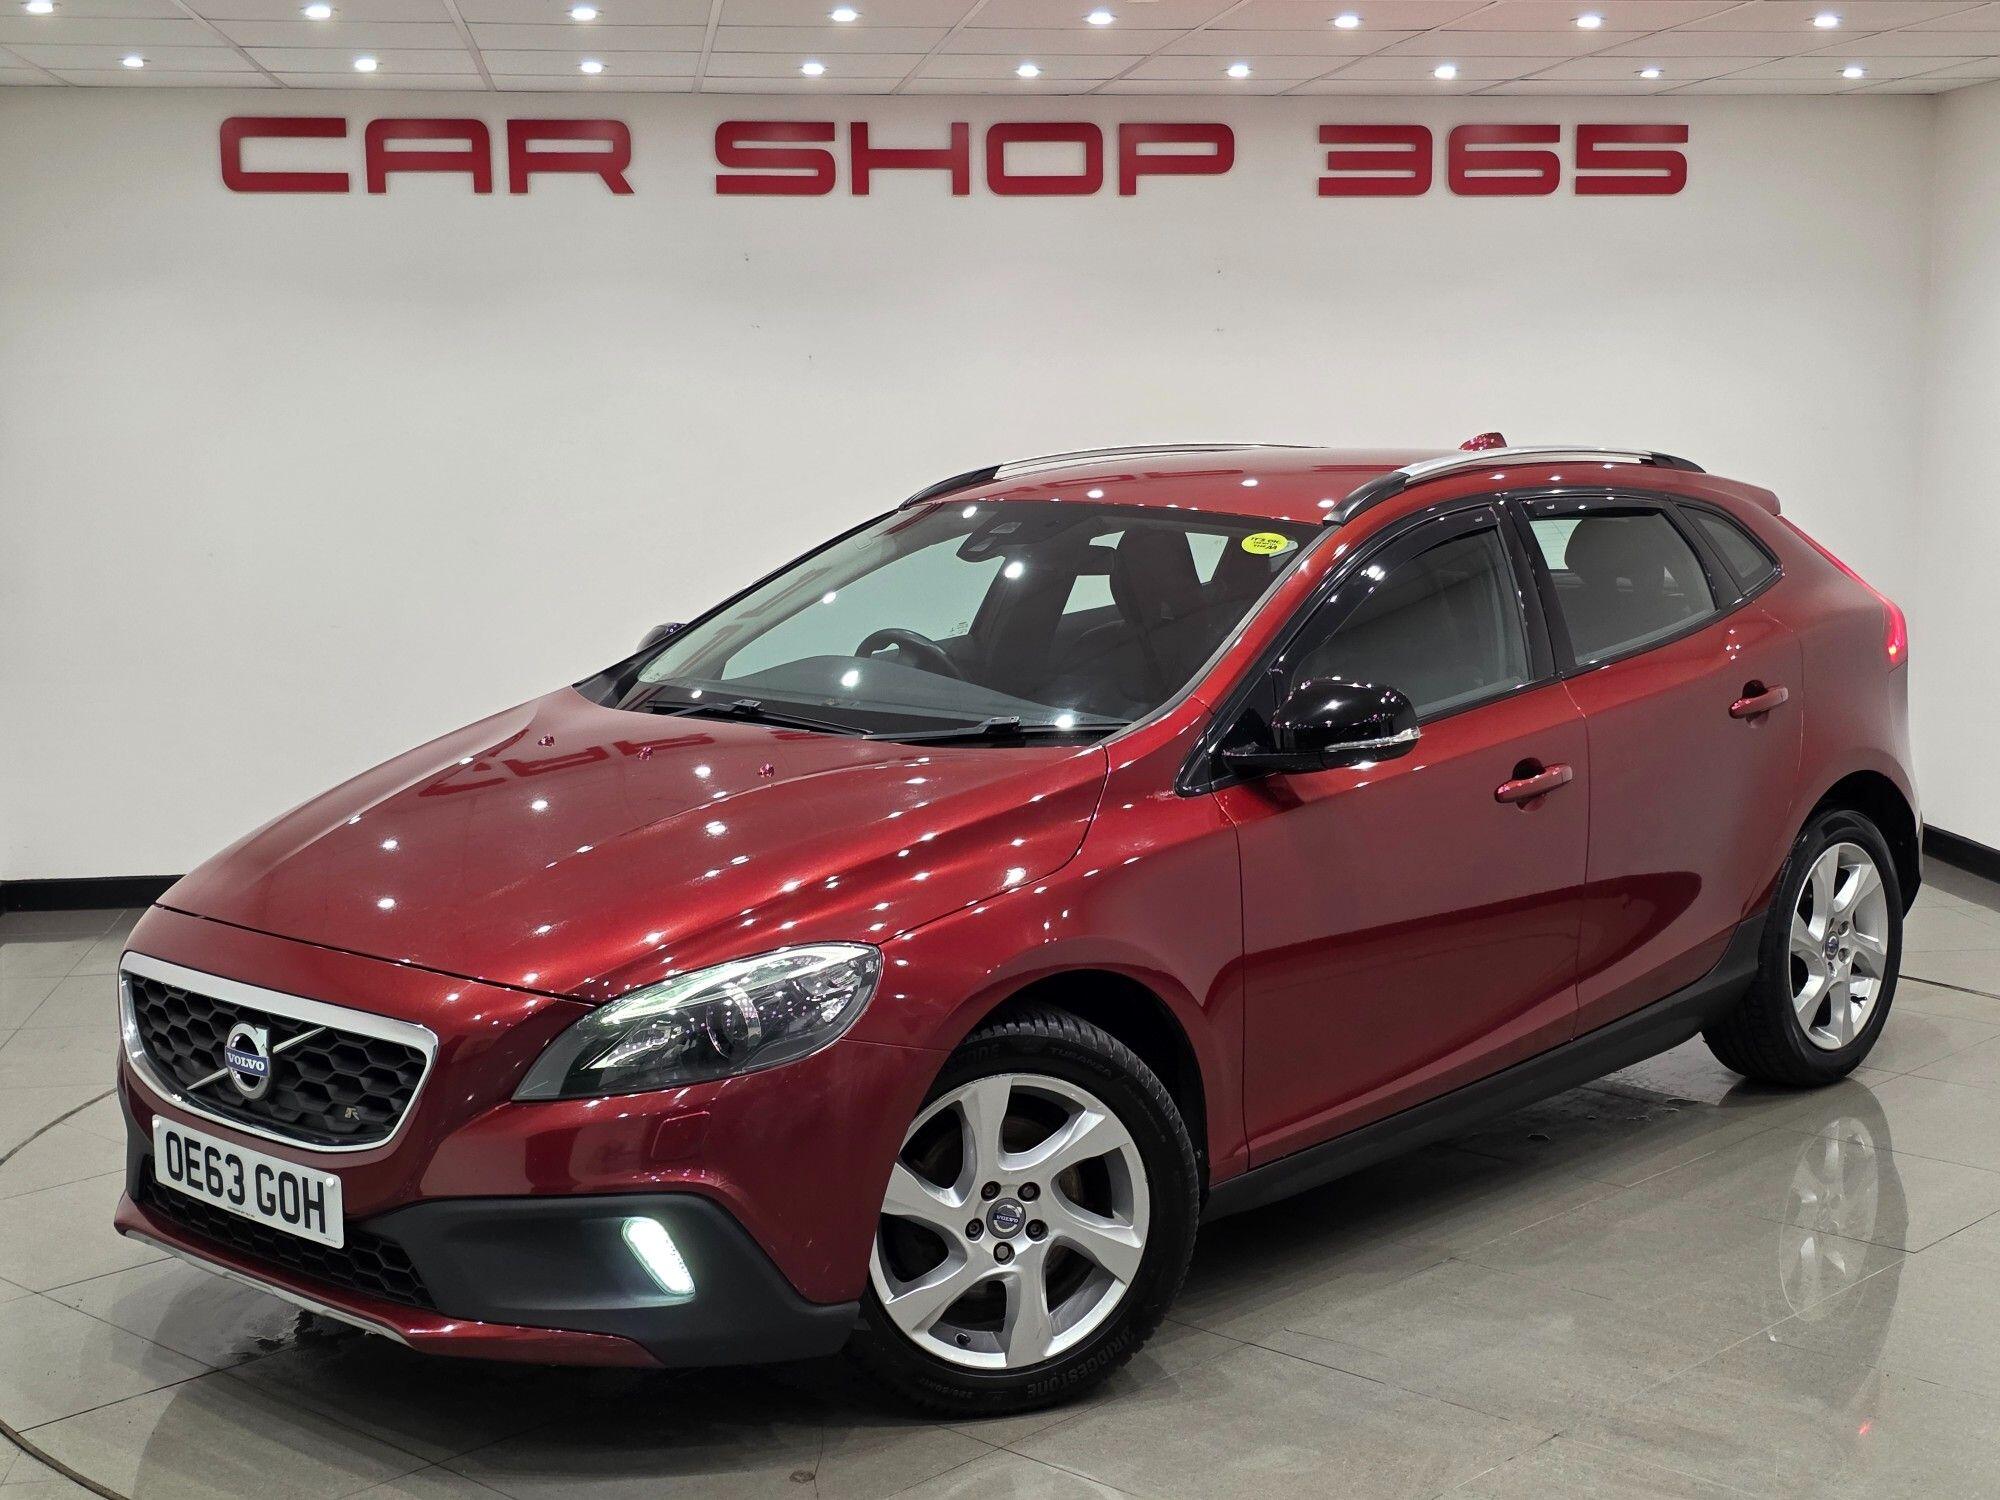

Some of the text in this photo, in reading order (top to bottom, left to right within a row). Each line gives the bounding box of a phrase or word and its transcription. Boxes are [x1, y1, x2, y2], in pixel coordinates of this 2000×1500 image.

[221, 118, 1689, 196] CAR SHOP 365
[227, 1052, 266, 1072] VOLVO
[165, 1131, 327, 1234] OE63 GOH
